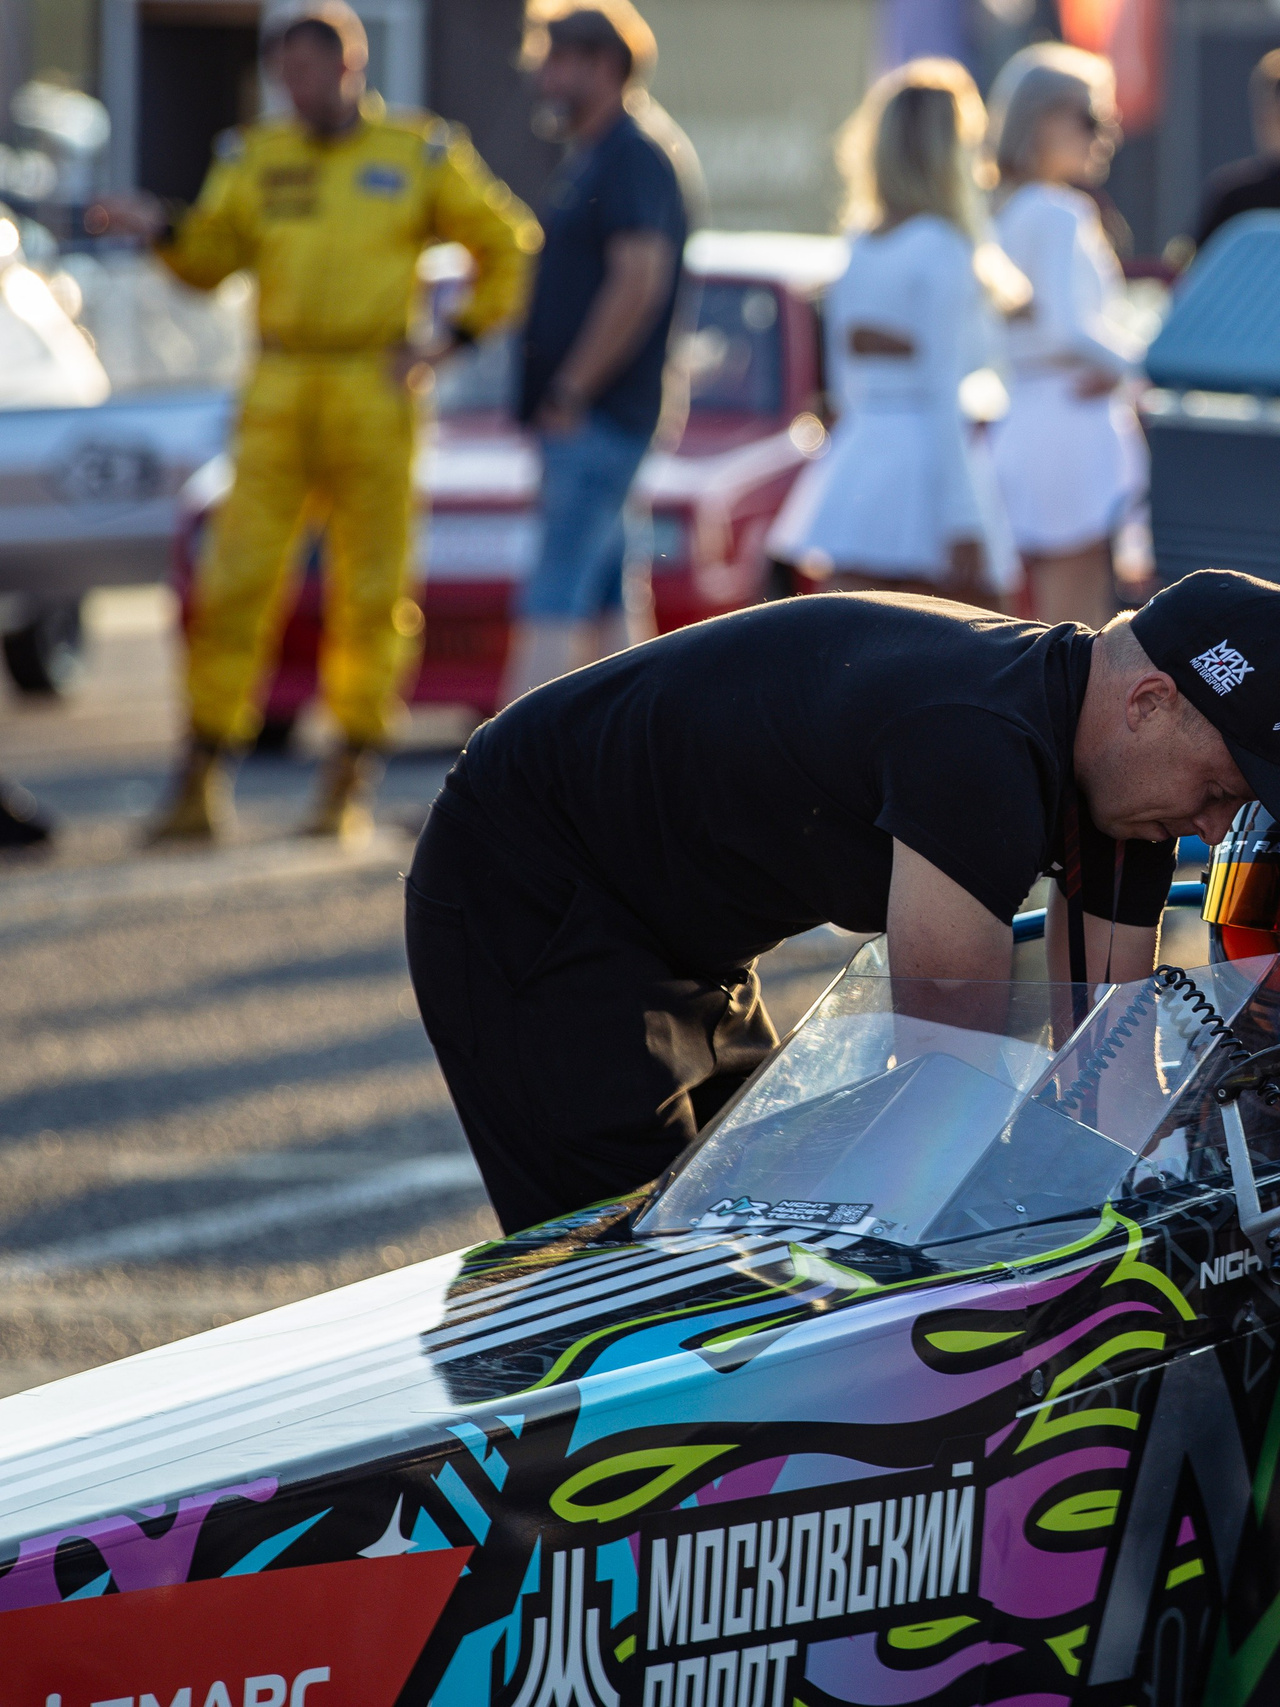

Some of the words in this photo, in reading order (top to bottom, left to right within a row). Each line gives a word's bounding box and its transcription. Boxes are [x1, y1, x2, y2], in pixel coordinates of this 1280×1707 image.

[1189, 657, 1229, 697] MOTORSPORT
[1196, 649, 1242, 692] RIDE
[1212, 639, 1255, 681] MAX
[766, 1212, 815, 1221] TEAM
[771, 1207, 831, 1216] RACER
[780, 1200, 832, 1209] NIGHT
[646, 1461, 976, 1651] МОСКОВСКИЙ
